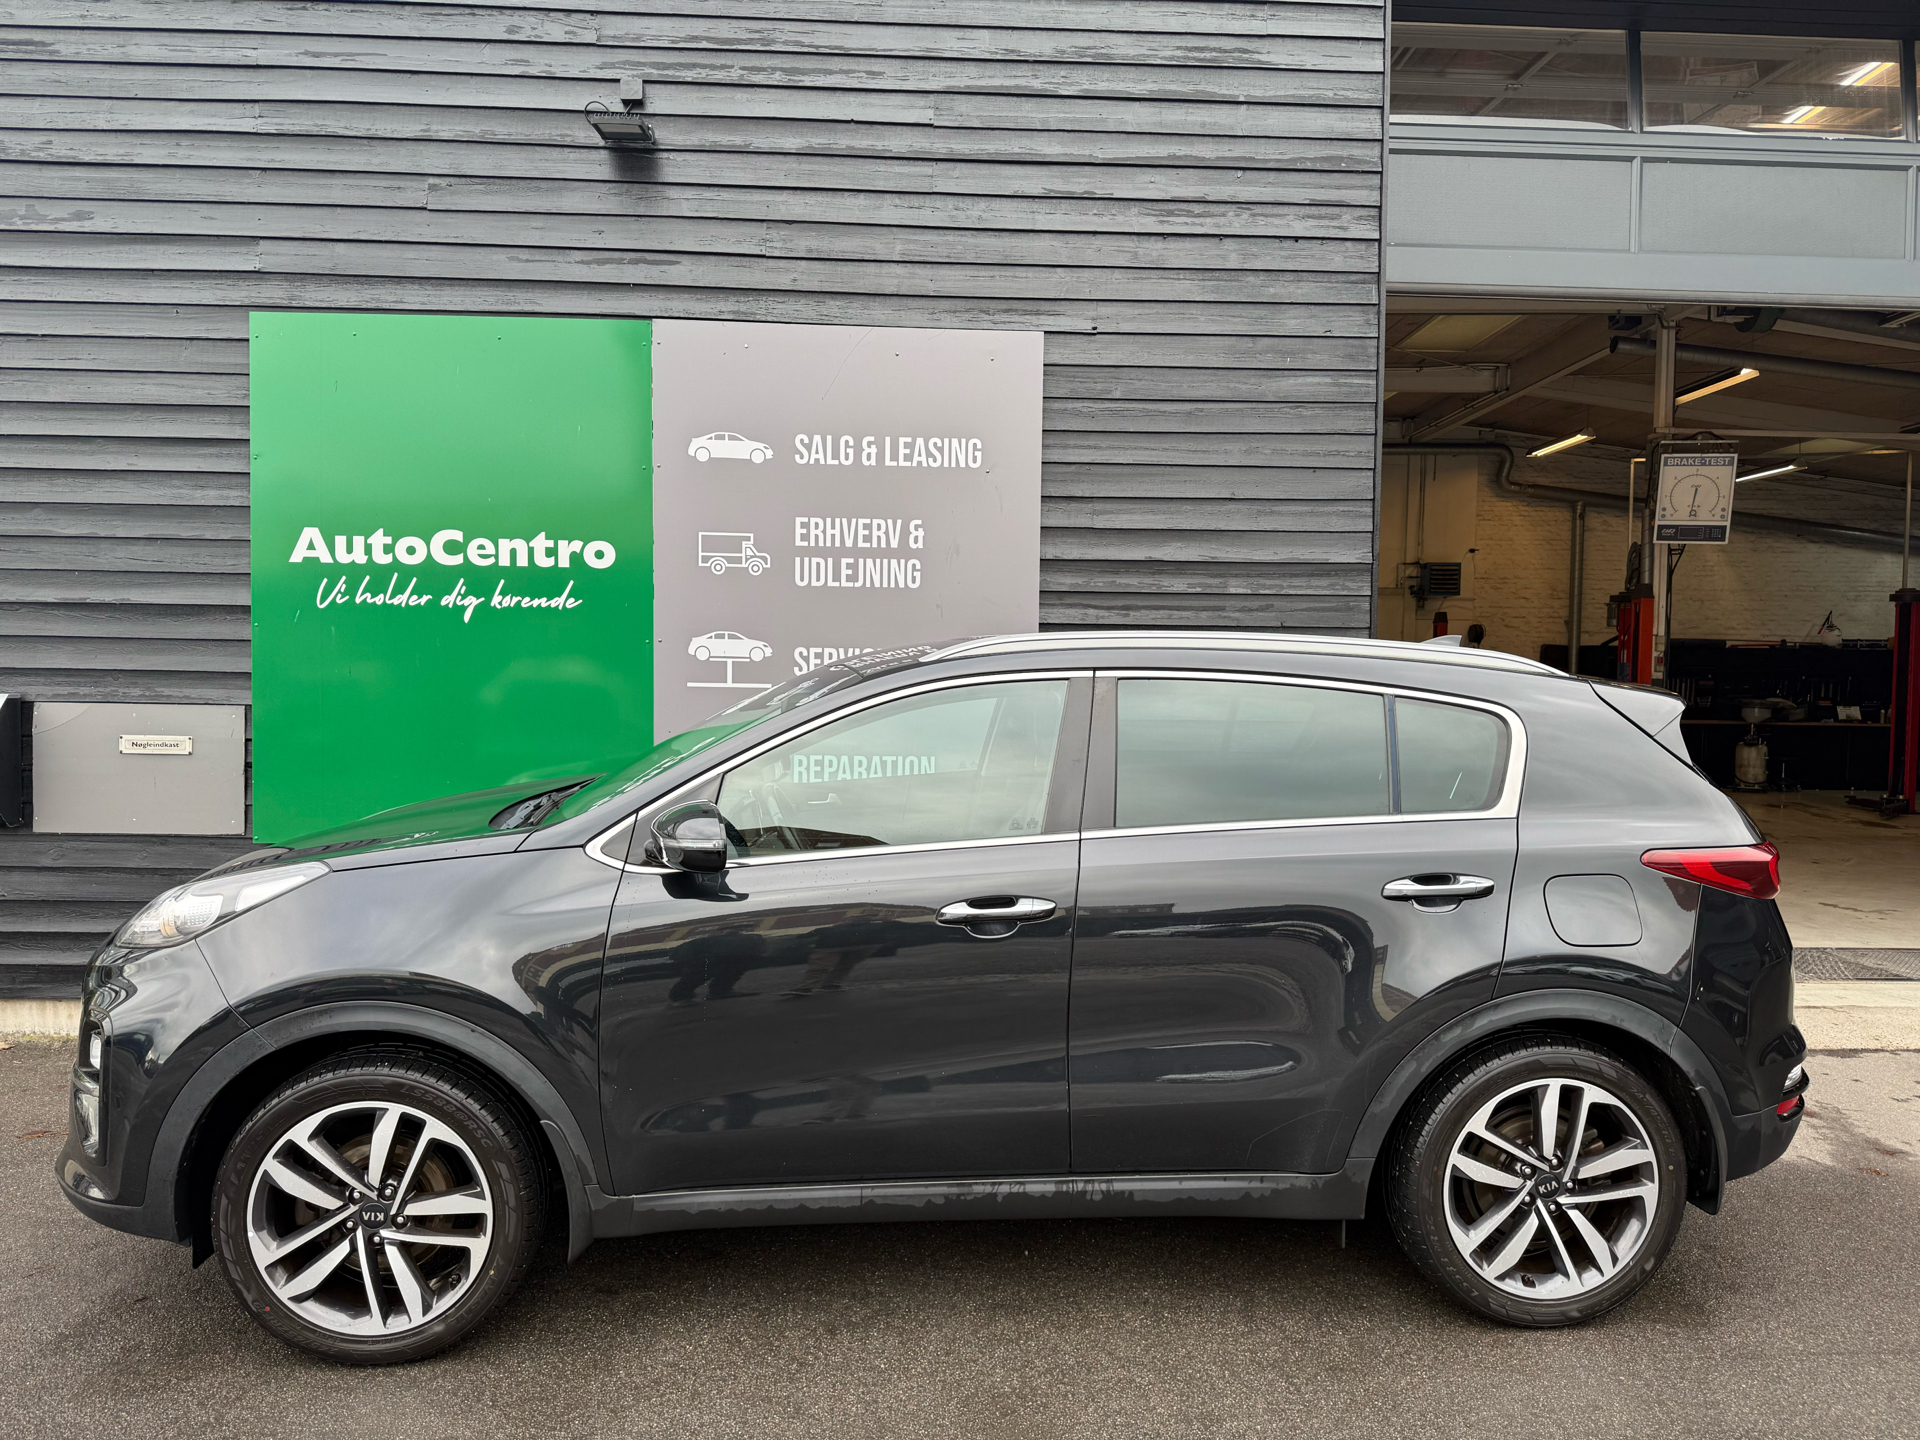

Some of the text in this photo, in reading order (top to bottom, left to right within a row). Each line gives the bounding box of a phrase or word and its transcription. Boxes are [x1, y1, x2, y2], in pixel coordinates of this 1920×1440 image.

[794, 433, 982, 468] SALG & LEASING
[1667, 457, 1731, 466] BRAKE-TEST
[288, 526, 616, 569] AutoCentro
[794, 516, 925, 549] ERHVERV &
[794, 557, 922, 588] UDLEJNING
[316, 572, 583, 624] Vi holder dig kørende
[793, 754, 936, 784] REPARATION
[1538, 1180, 1559, 1194] KIA
[362, 1211, 385, 1222] KIA
